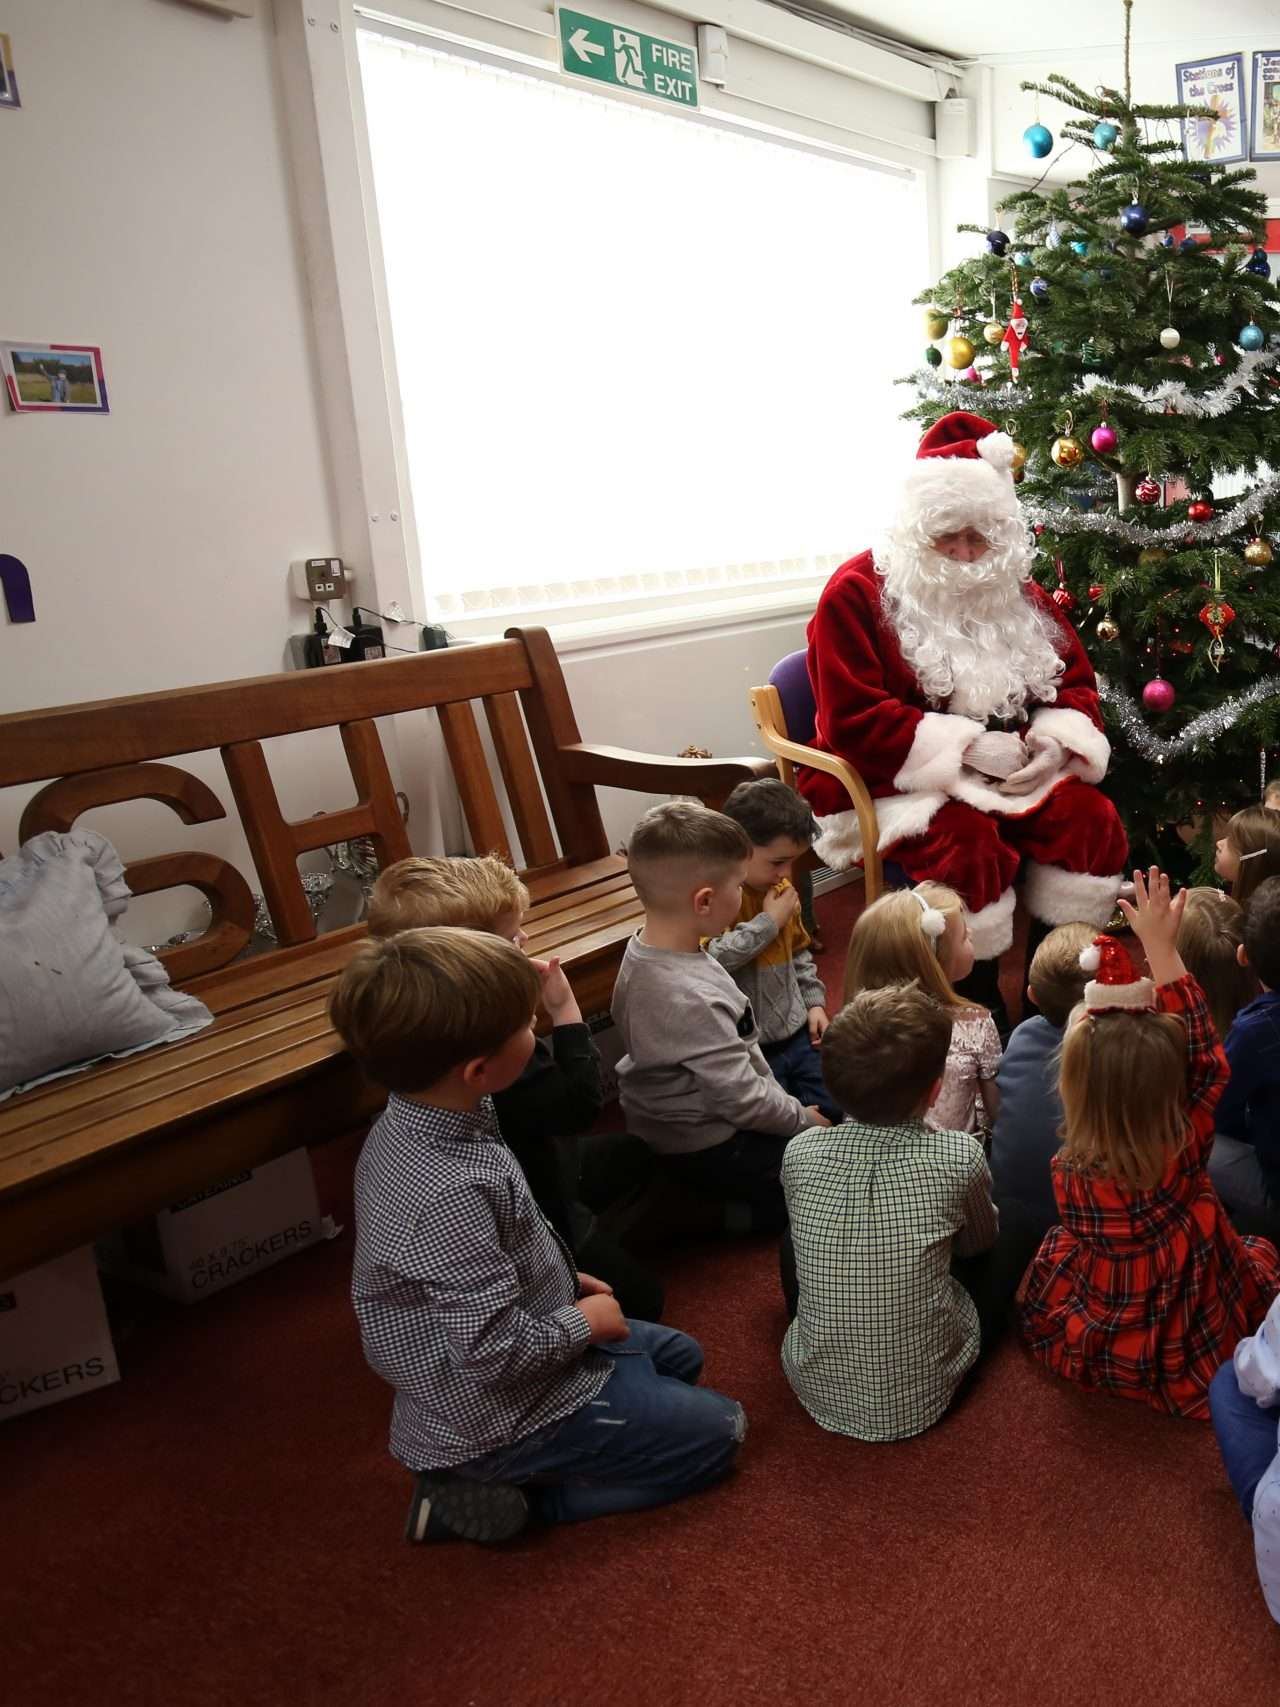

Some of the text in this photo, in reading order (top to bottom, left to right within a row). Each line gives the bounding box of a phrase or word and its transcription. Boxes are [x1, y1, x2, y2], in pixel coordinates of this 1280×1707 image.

[652, 43, 692, 73] FIRE
[1255, 53, 1261, 68] 1
[1183, 62, 1236, 82] Stations of
[654, 73, 693, 100] EXIT
[1189, 82, 1234, 96] the Cross
[192, 1220, 312, 1289] CRACKERS
